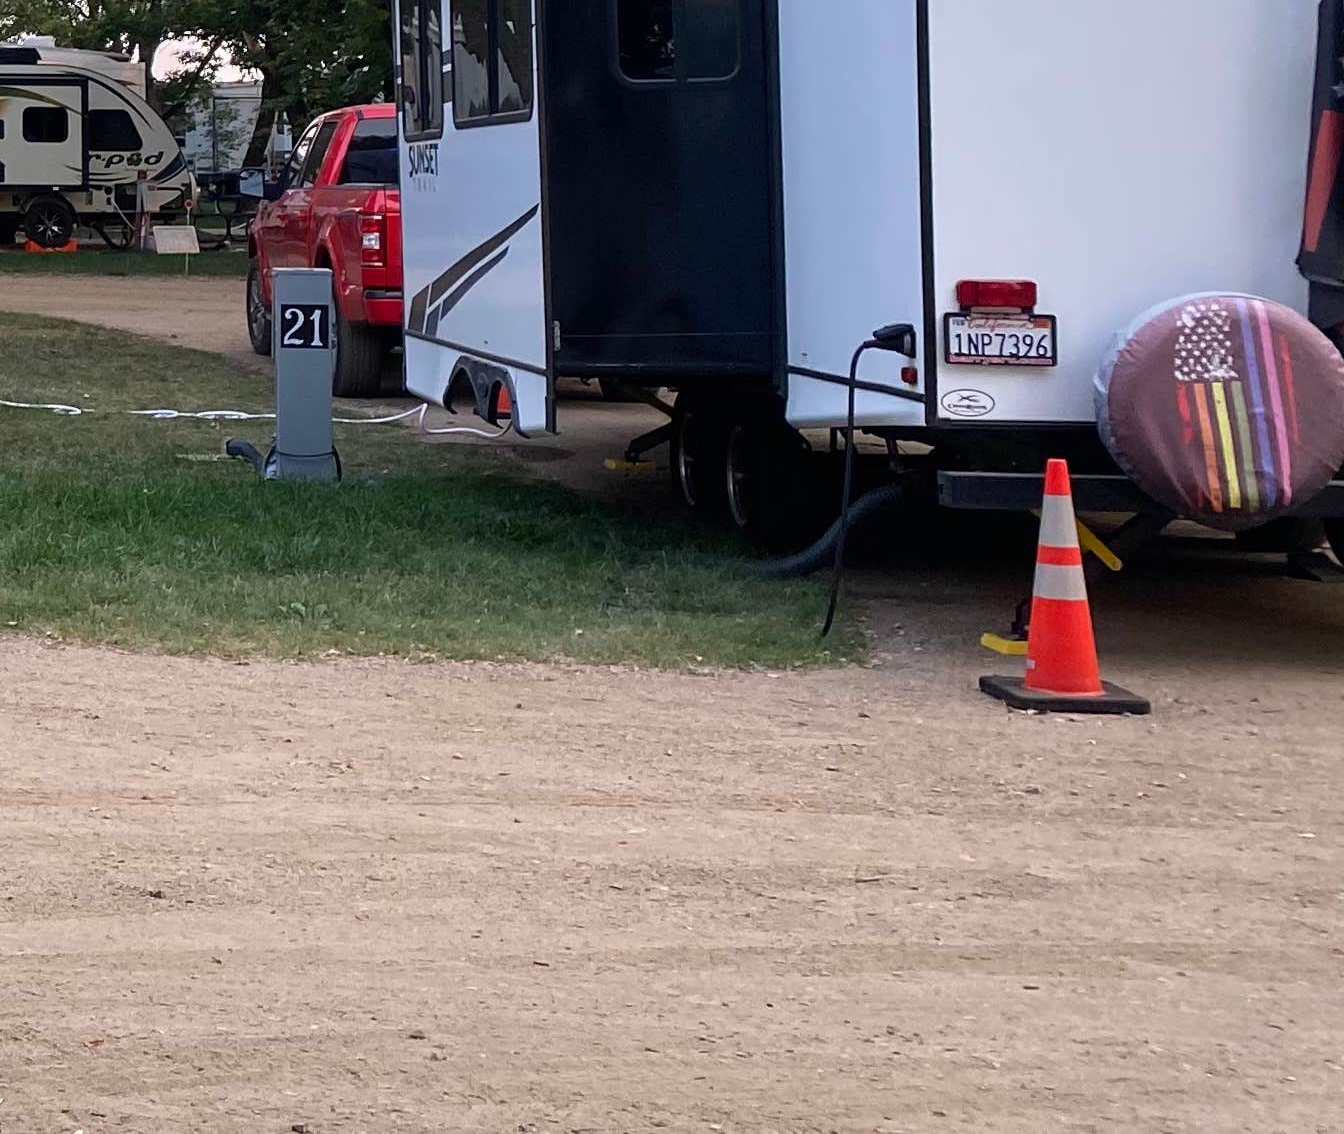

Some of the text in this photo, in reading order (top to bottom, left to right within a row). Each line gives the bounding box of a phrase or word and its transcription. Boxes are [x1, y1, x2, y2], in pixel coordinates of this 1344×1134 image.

[409, 143, 438, 178] SUNSET
[283, 308, 323, 346] 21
[955, 333, 1049, 357] 1NP7396
